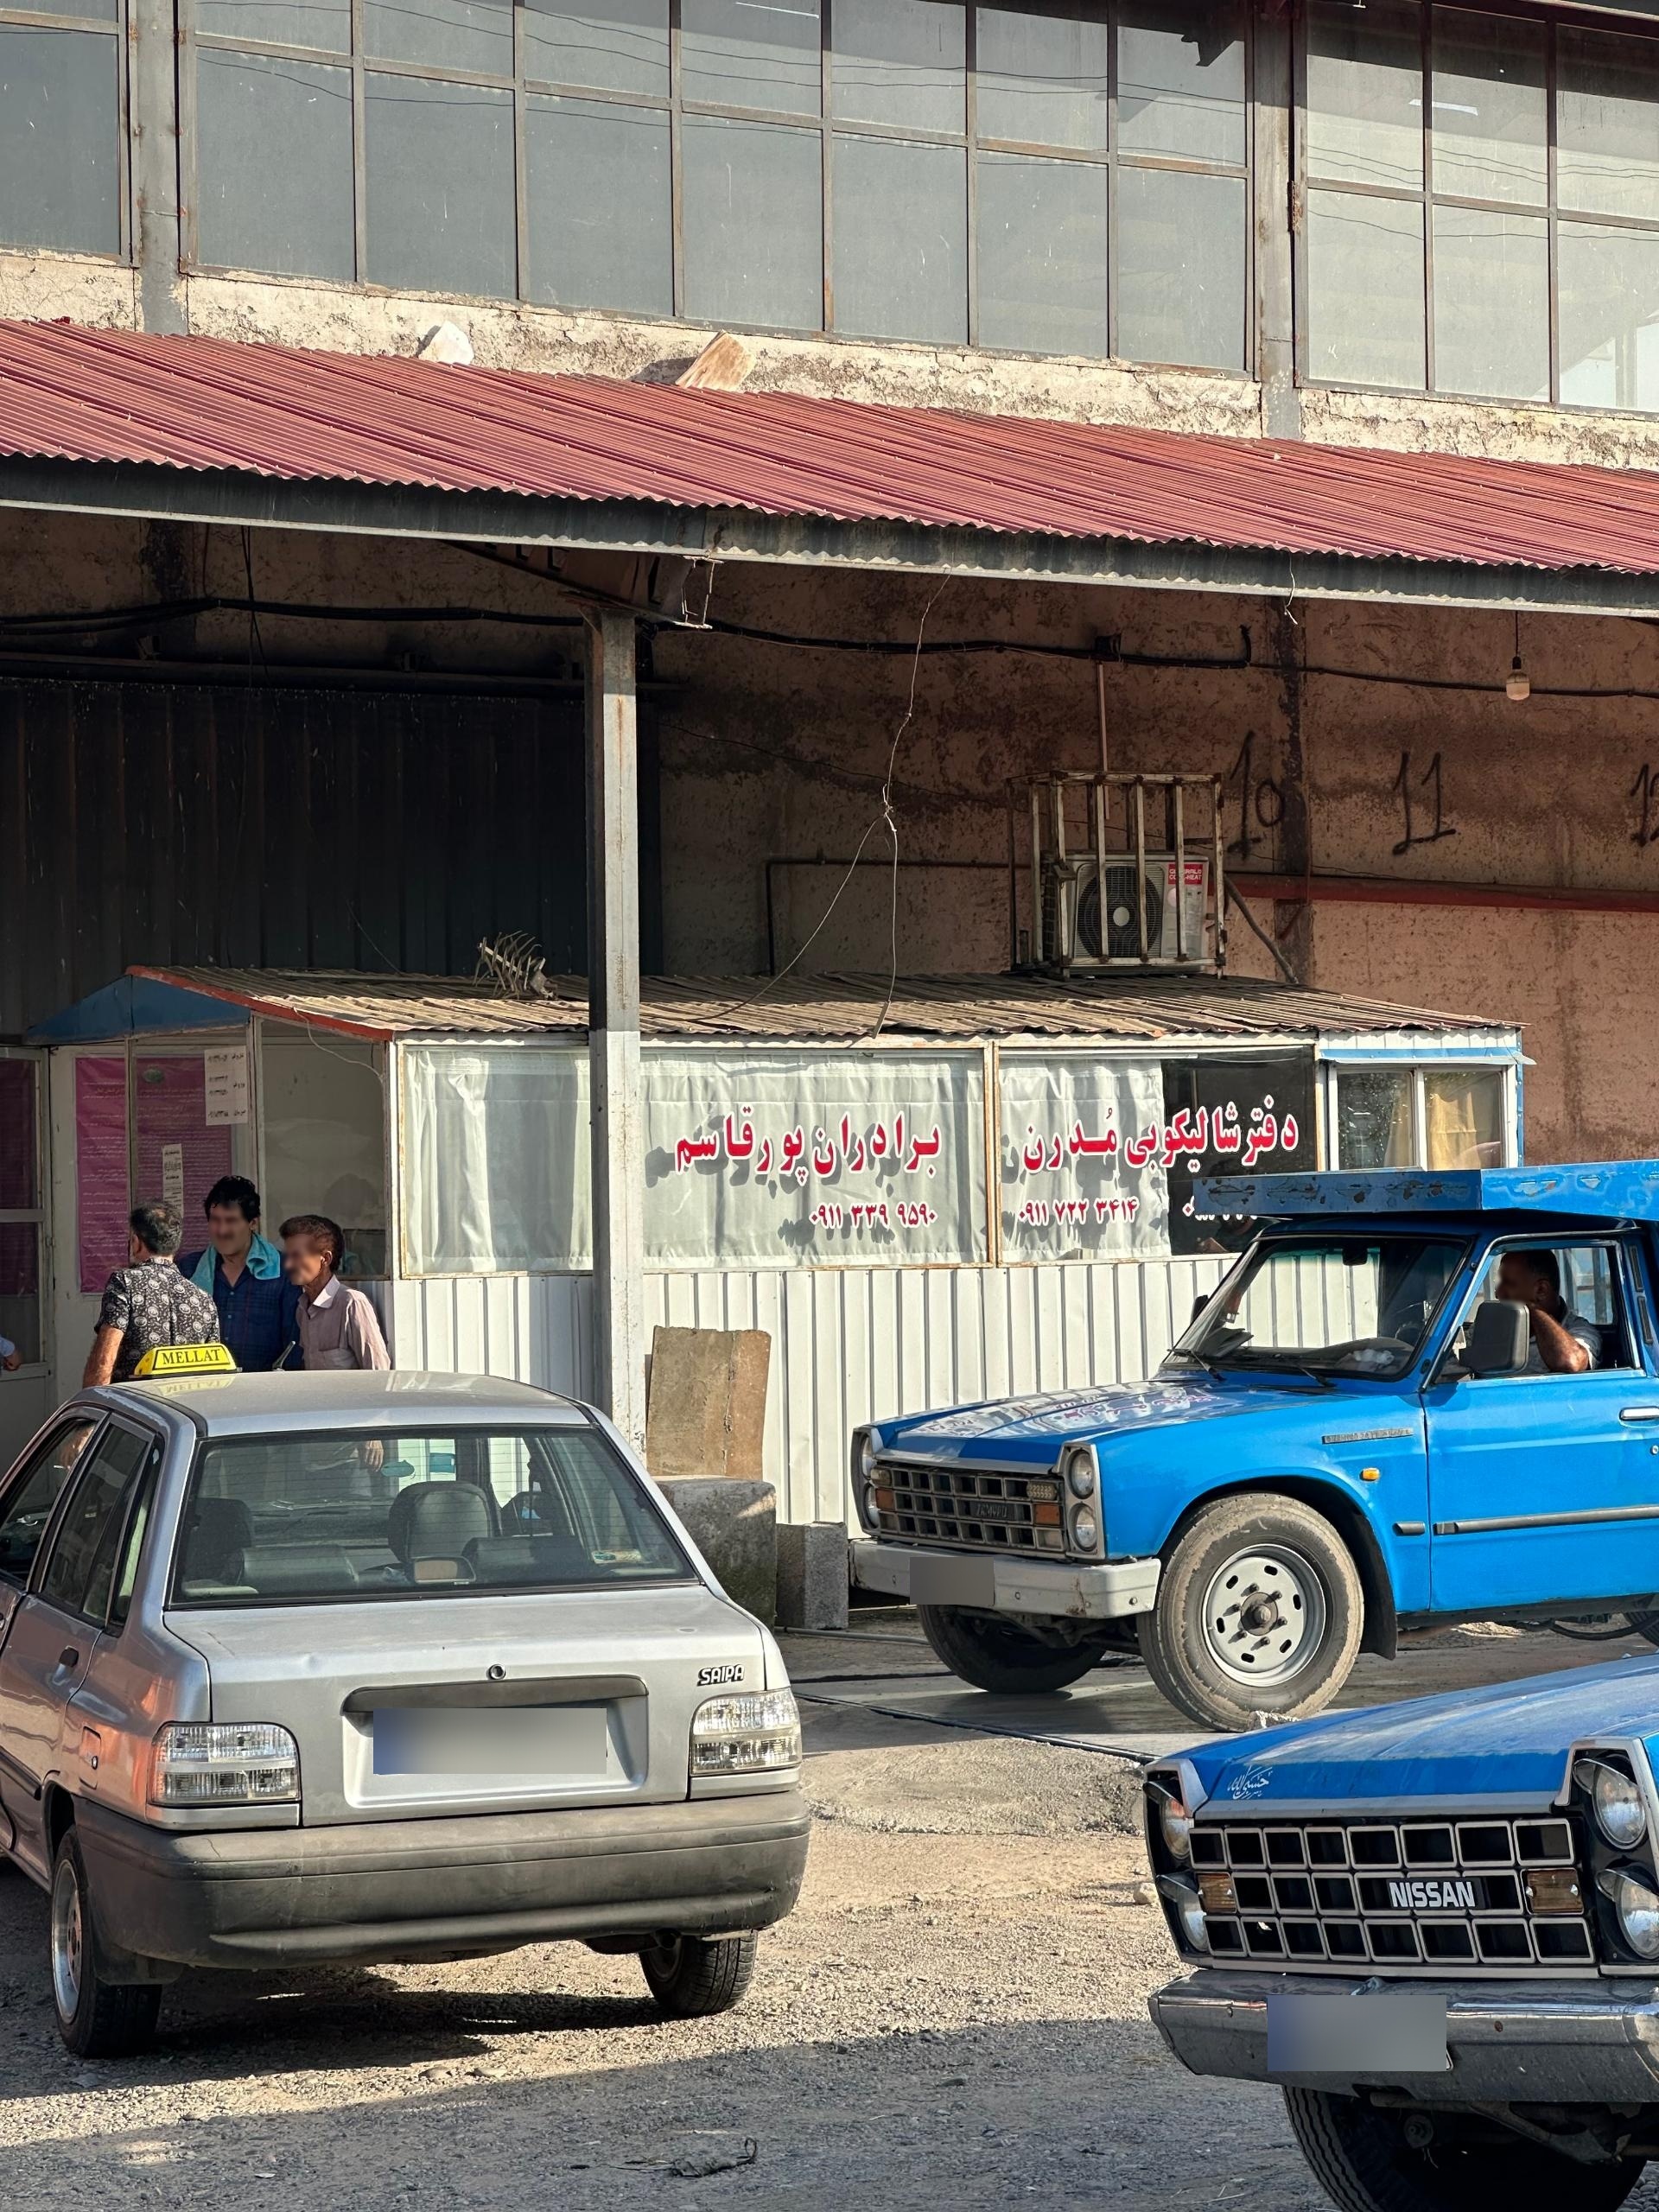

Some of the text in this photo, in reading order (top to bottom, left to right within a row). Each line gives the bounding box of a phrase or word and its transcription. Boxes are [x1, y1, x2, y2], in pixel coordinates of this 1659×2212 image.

[1392, 751, 1457, 855] 11
[814, 1111, 940, 1176] برادران
[1243, 1095, 1298, 1166] دفتر
[810, 1202, 938, 1228] ۰۹۱۱ ۳۳۹ ۹۵۹۰
[1019, 1201, 1048, 1224] ۰۹۱۱
[162, 1349, 219, 1364] MELLAT
[697, 1663, 744, 1686] SAIPA
[1389, 1881, 1476, 1908] NISSAN
